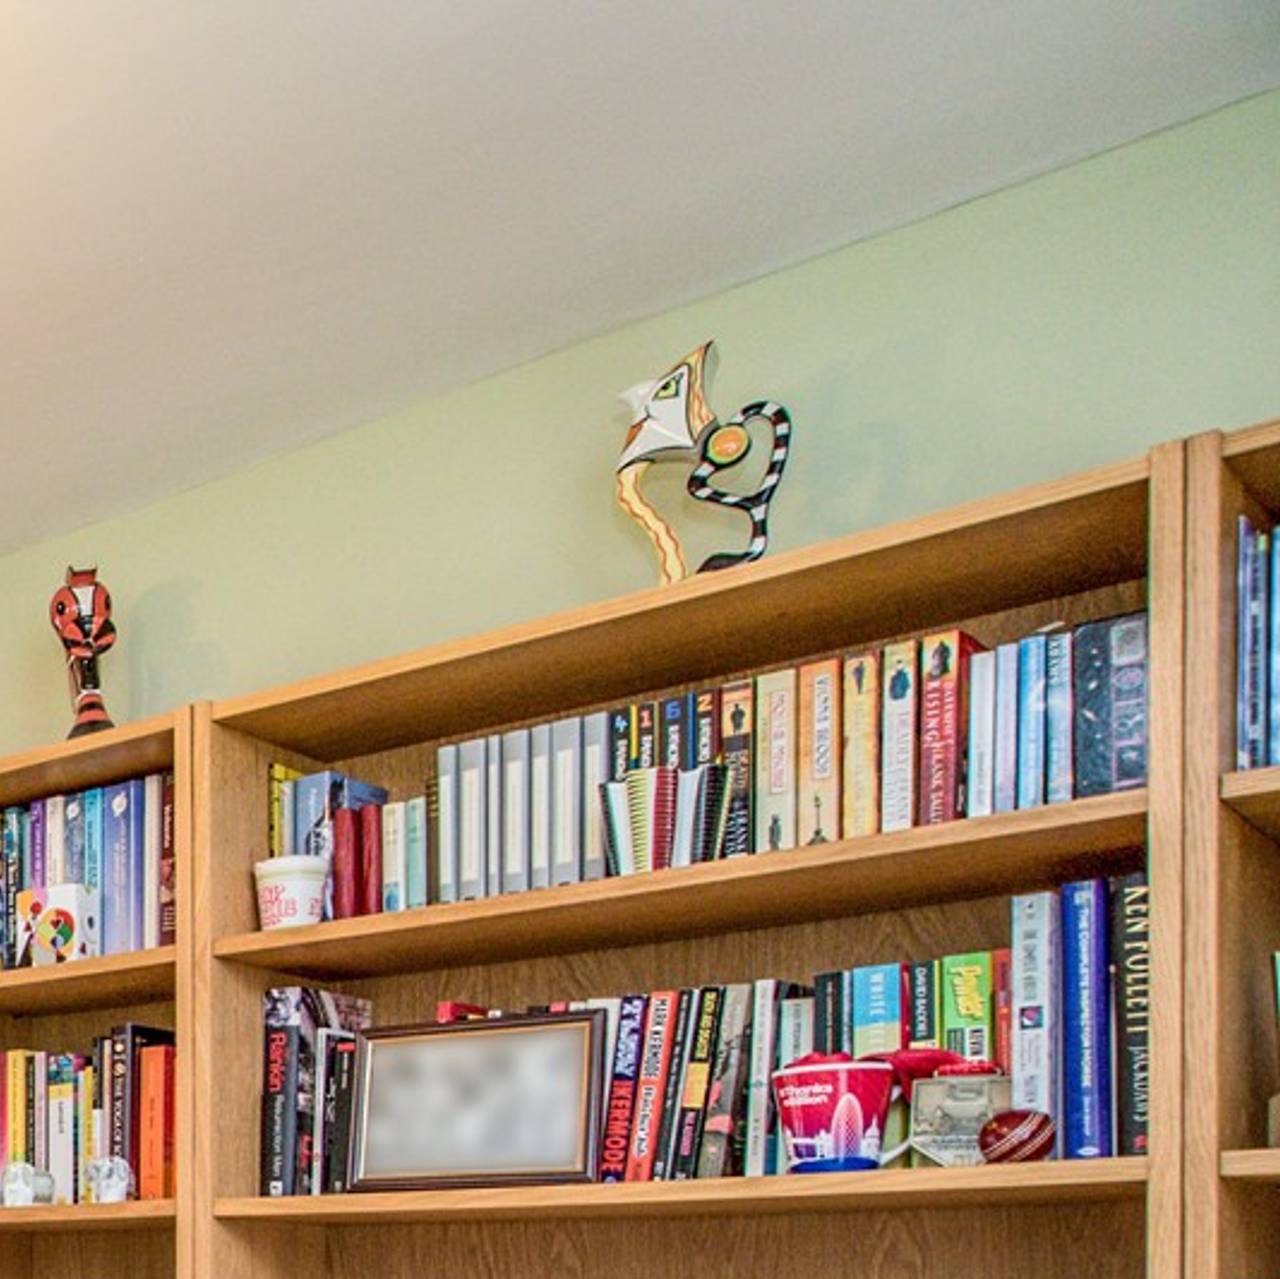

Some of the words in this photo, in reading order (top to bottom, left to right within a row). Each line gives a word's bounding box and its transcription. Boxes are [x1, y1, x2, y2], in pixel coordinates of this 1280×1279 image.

[698, 694, 712, 710] 2
[1125, 886, 1149, 932] KEN
[869, 974, 885, 1016] WHITE
[1126, 941, 1149, 1033] FOLLETT
[654, 999, 669, 1026] MARK
[270, 1032, 287, 1092] Rankin
